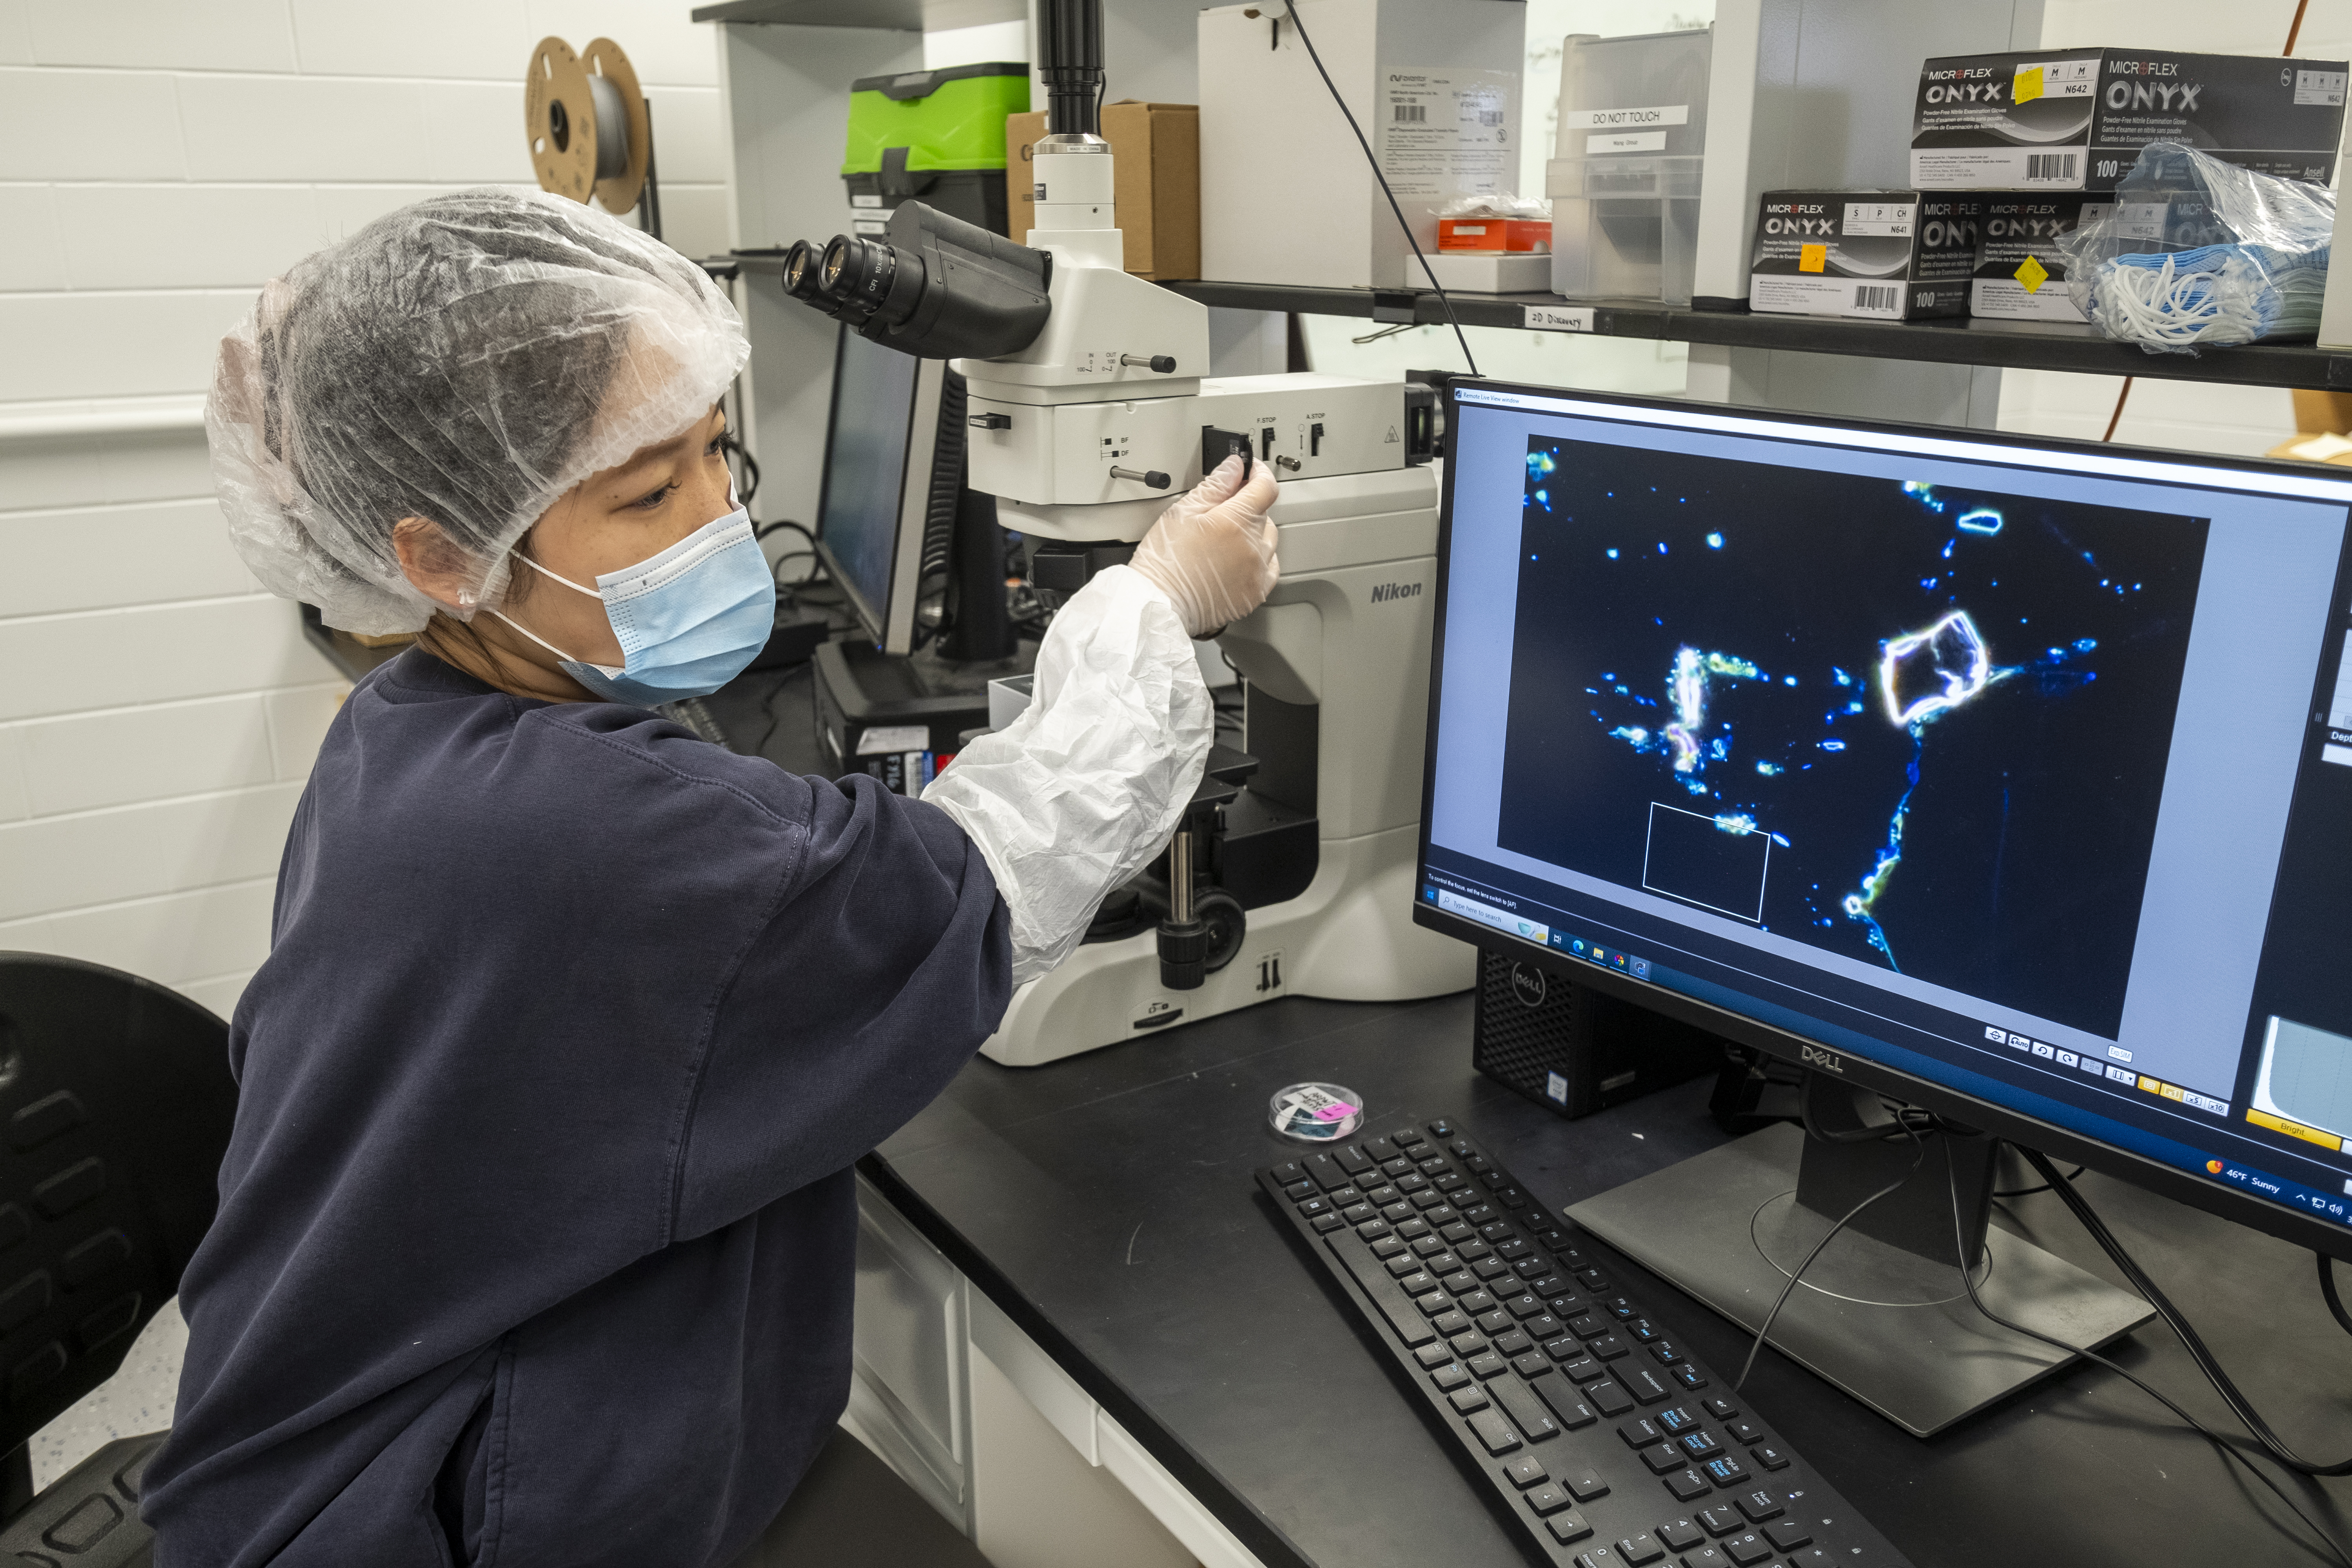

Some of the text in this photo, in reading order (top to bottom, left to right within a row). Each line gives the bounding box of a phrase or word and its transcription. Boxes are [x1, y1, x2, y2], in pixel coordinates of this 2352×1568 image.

[1929, 68, 1993, 80] MICROFLEX
[2051, 68, 2059, 76] M
[2078, 67, 2085, 75] M
[2109, 61, 2178, 76] MICROFLEX
[1926, 82, 2004, 103] ONYX
[2065, 85, 2087, 94] N642
[2106, 80, 2201, 113] ONYX
[1592, 111, 1660, 124] DO NOT TOUCH
[2097, 160, 2118, 178] 100
[2303, 166, 2325, 177] Ansell
[1767, 204, 1824, 214] MICROFLEX
[1990, 205, 2056, 214] MICROFLEX
[1765, 217, 1836, 236] ONYX
[1891, 225, 1907, 234] N641
[1987, 218, 2069, 237] ONYX
[2132, 226, 2154, 235] N642
[869, 279, 878, 291] CFI
[1916, 292, 1935, 308] 100
[1371, 582, 1422, 603] Nikon
[1489, 894, 1502, 903] switch
[1454, 900, 1465, 909] Type
[1466, 906, 1477, 914] here
[1485, 912, 1502, 923] search
[1801, 1045, 1843, 1073] DELL
[2110, 1047, 2131, 1059] Exp.SIM
[2227, 1169, 2280, 1194] 46°F Sunny
[1639, 1319, 1649, 1327] F10
[1684, 1364, 1695, 1373] F12
[1641, 1371, 1663, 1392] Backspace
[1577, 1404, 1590, 1416] Enter
[1667, 1410, 1681, 1423] Print
[1676, 1407, 1691, 1423] Insert
[1541, 1418, 1553, 1429] Shift
[1640, 1419, 1655, 1434] Delete
[1661, 1412, 1678, 1428] Screen
[1506, 1433, 1516, 1442] Ctrl
[1684, 1436, 1698, 1449] Lock
[1690, 1434, 1707, 1449] Scroll
[1699, 1432, 1715, 1447] Home
[1662, 1444, 1675, 1454] End
[1709, 1461, 1725, 1477] Break
[1715, 1460, 1731, 1476] Pause
[1724, 1457, 1739, 1472] PgUp
[1686, 1470, 1700, 1485] PgDn
[1751, 1493, 1766, 1506] Lock
[1758, 1491, 1771, 1504] Num
[1703, 1510, 1718, 1525] Home
[1622, 1539, 1634, 1550] End
[1582, 1554, 1597, 1568] Insert
